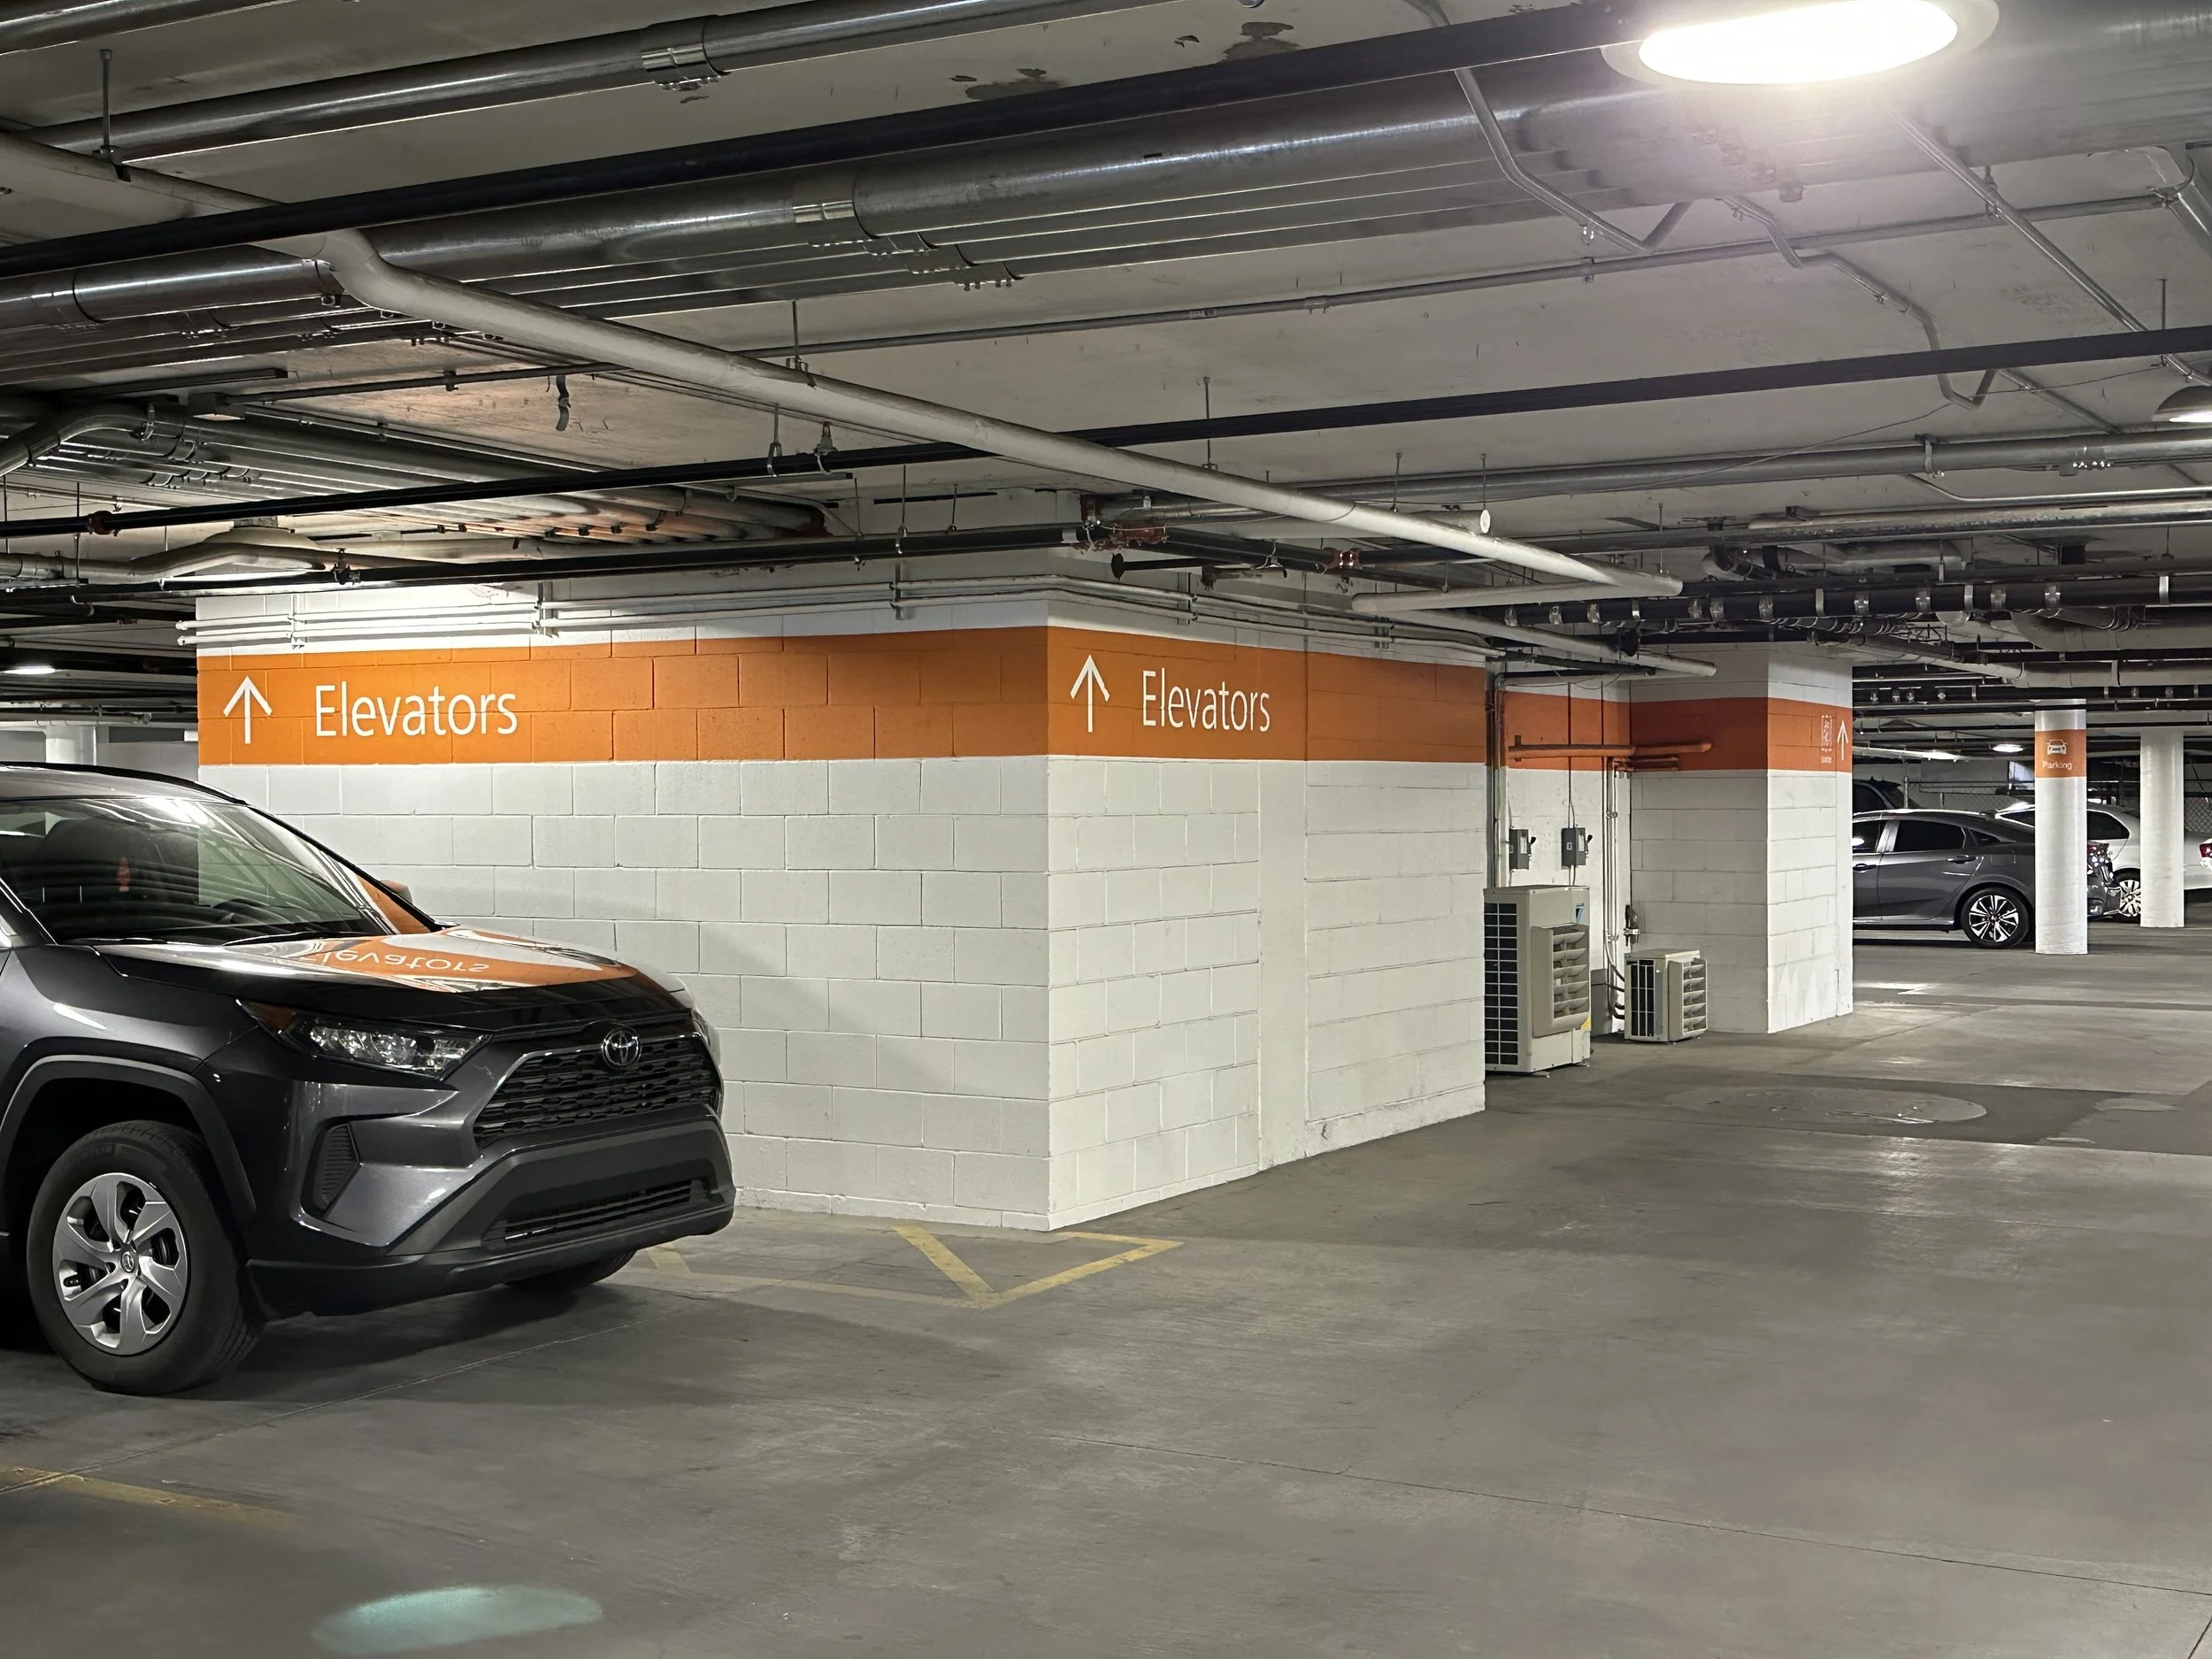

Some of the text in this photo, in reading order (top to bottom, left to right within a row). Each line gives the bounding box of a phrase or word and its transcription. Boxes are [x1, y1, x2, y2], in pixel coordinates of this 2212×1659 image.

[315, 680, 518, 736] Elevators
[1142, 667, 1271, 732] Elevators
[2042, 761, 2072, 771] Parking
